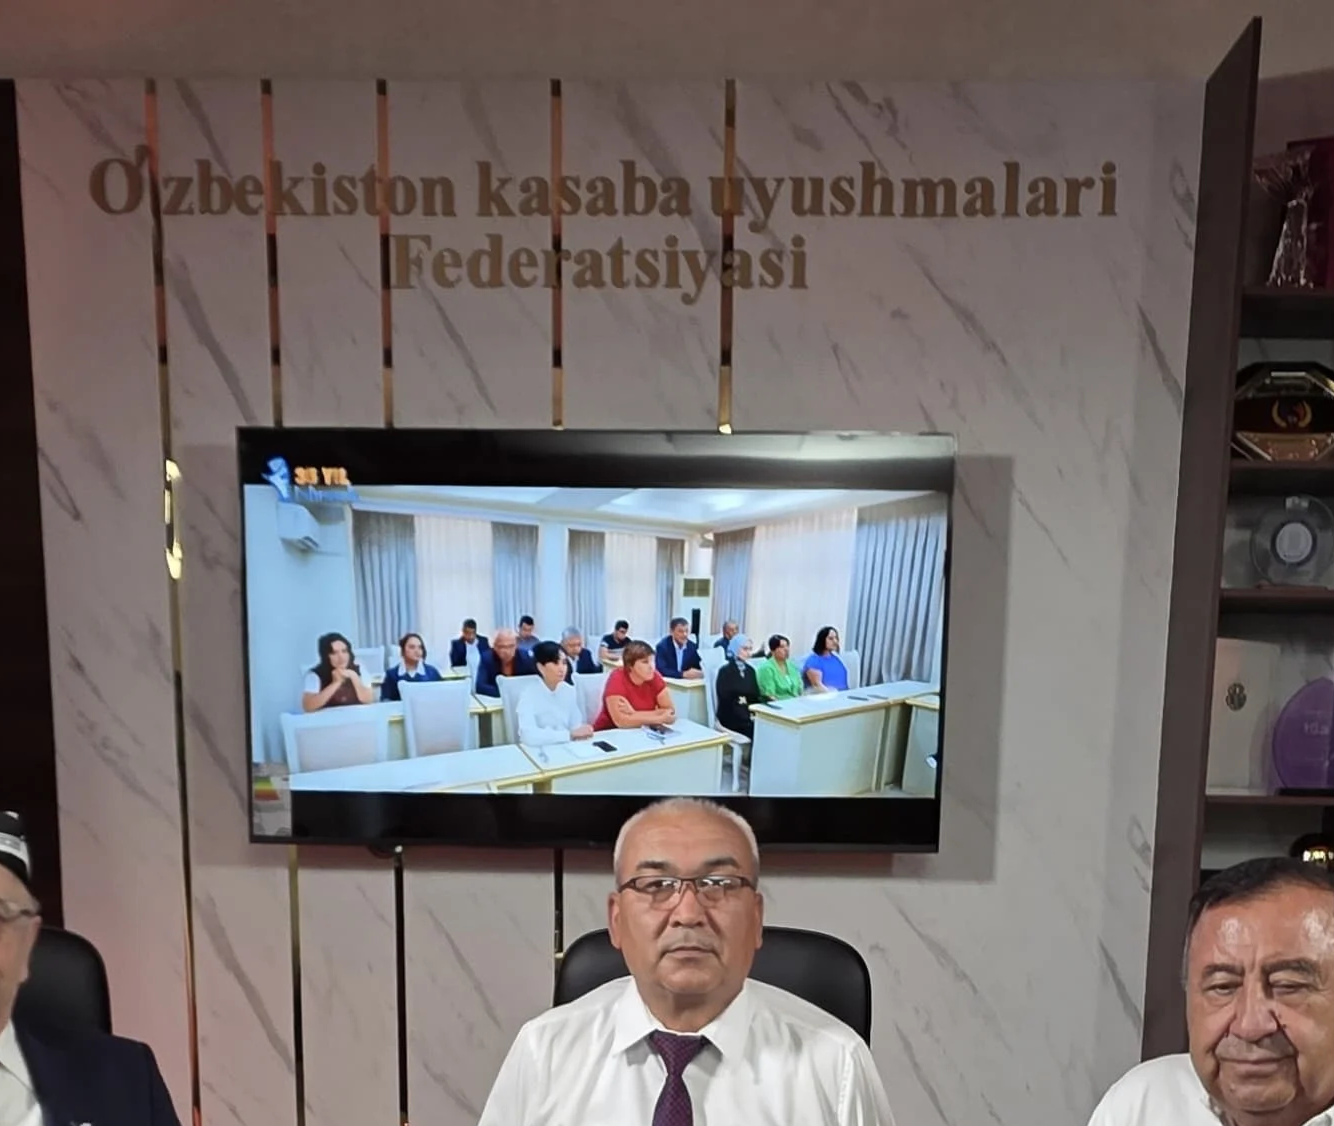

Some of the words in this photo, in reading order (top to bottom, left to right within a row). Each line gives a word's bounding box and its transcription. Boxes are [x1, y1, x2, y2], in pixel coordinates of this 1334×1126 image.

[475, 159, 693, 217] kasaba
[709, 160, 1119, 233] uyushmalari
[388, 233, 809, 305] Federatsiyasi
